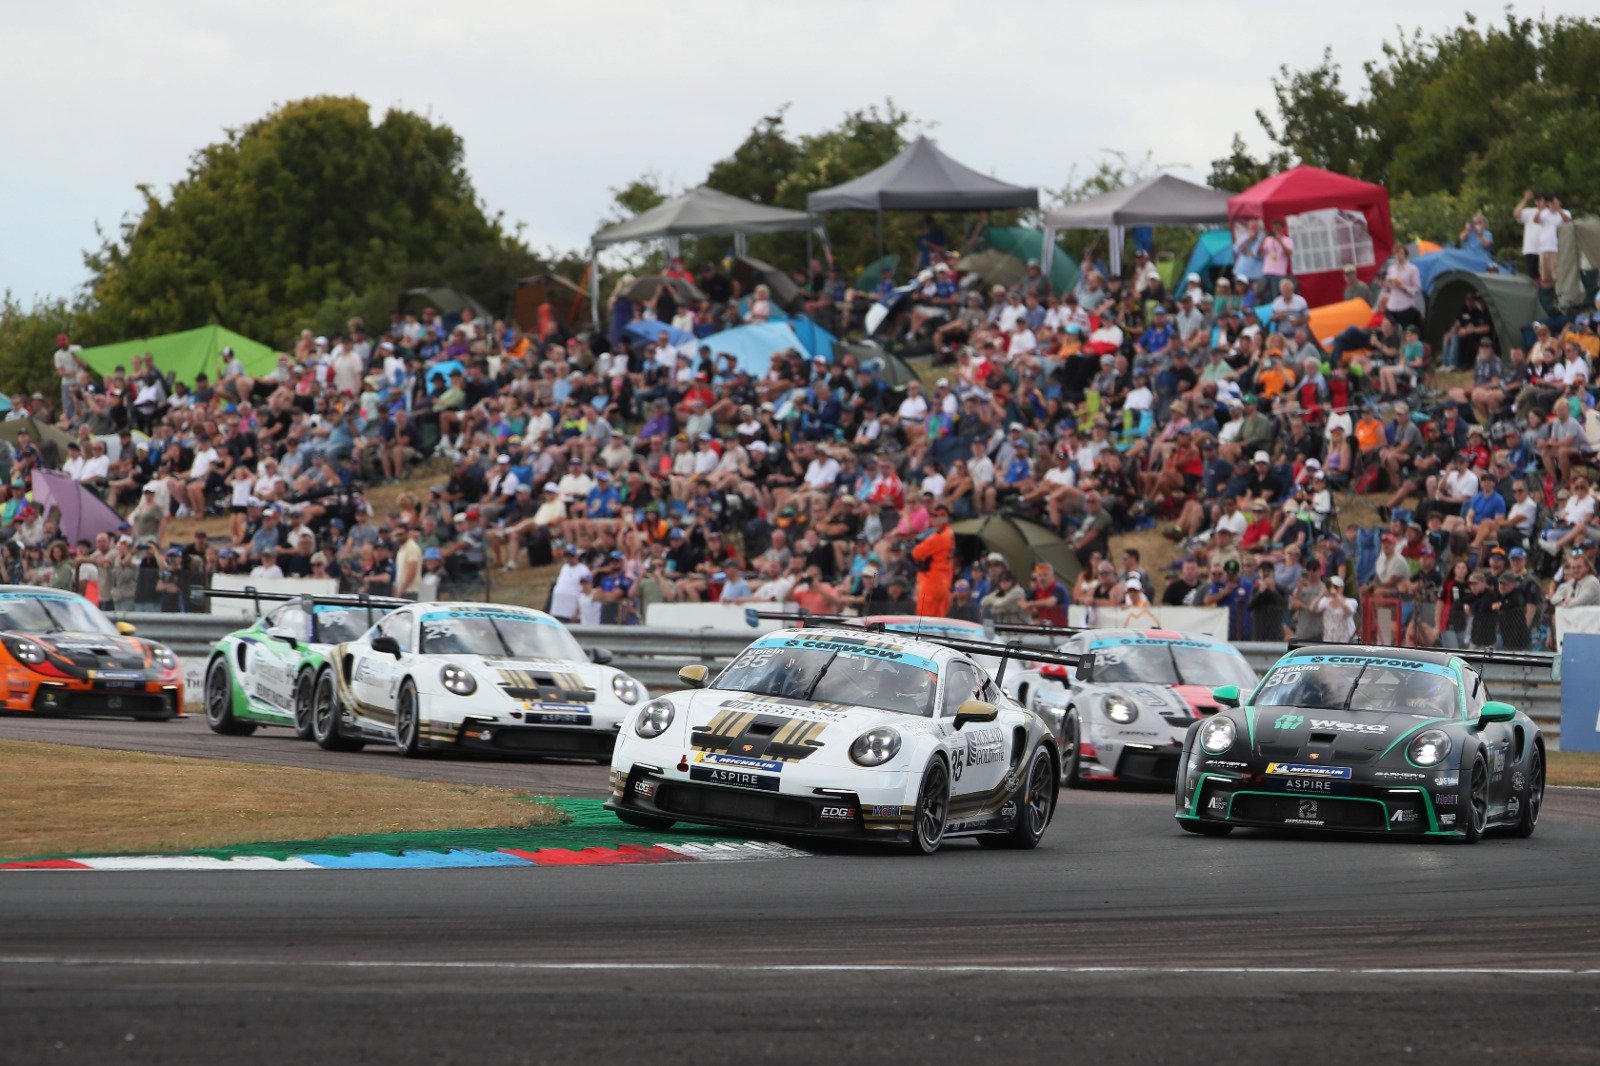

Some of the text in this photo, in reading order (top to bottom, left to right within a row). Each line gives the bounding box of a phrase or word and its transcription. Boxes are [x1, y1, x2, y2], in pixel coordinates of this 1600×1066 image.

[463, 611, 538, 622] carwow
[425, 625, 455, 640] 29
[803, 640, 904, 660] carwow
[1135, 639, 1212, 649] carwow
[747, 647, 787, 657] Voisin
[732, 654, 773, 670] 35
[1328, 655, 1424, 669] carwow
[1273, 664, 1321, 676] Jenkins
[1265, 671, 1302, 689] 30
[718, 757, 776, 770] MICHELIN
[1290, 767, 1345, 775] MICHELIN
[710, 770, 758, 785] ASPIRE
[1286, 779, 1331, 790] ASPIRE
[821, 807, 856, 817] EDGE
